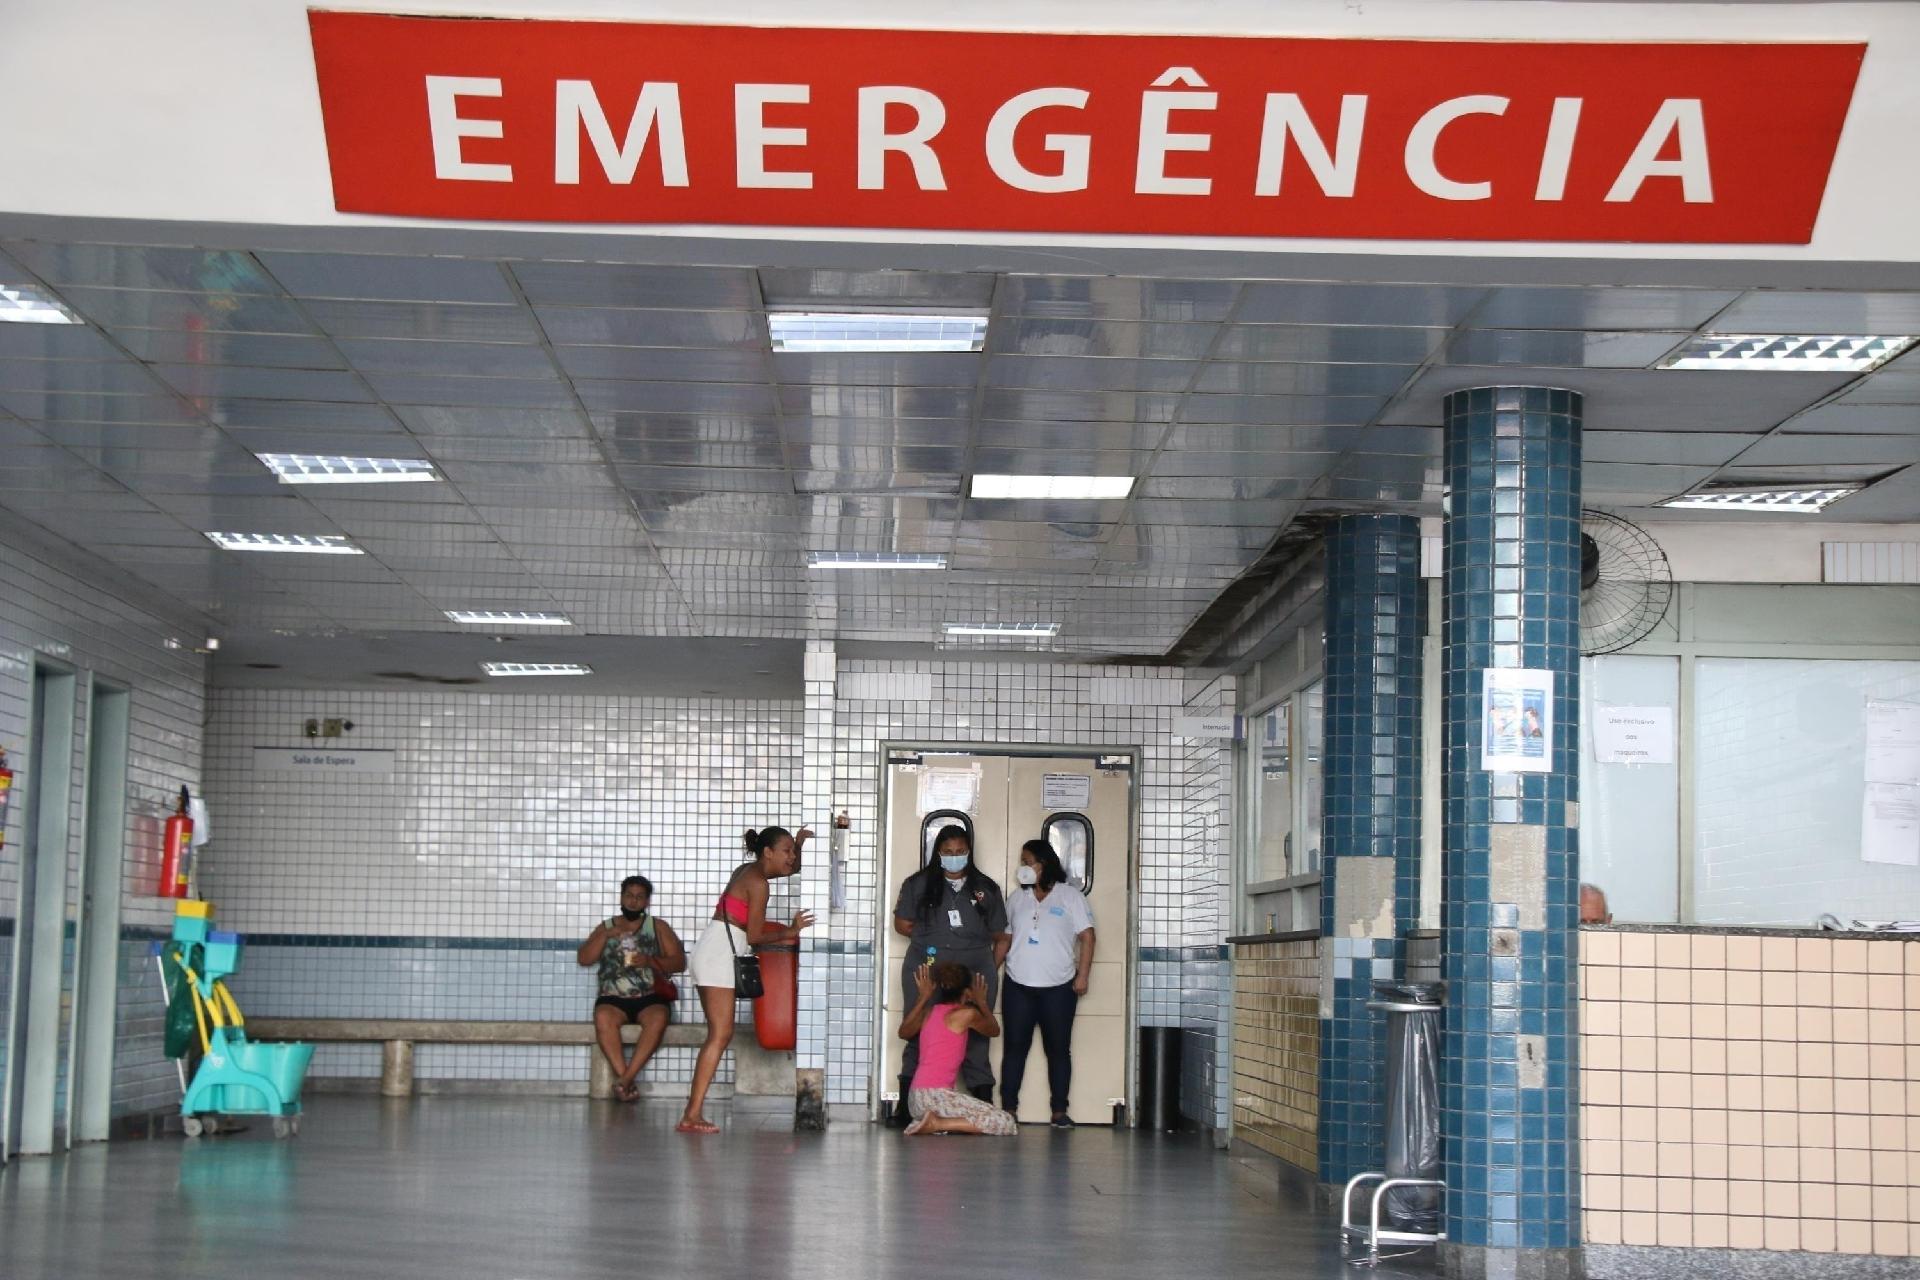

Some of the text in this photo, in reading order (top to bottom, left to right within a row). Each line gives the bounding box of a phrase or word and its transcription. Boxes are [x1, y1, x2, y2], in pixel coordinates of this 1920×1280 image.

[425, 66, 1714, 204] EMERGÊNCIA
[293, 755, 356, 765] Sala de Espera
